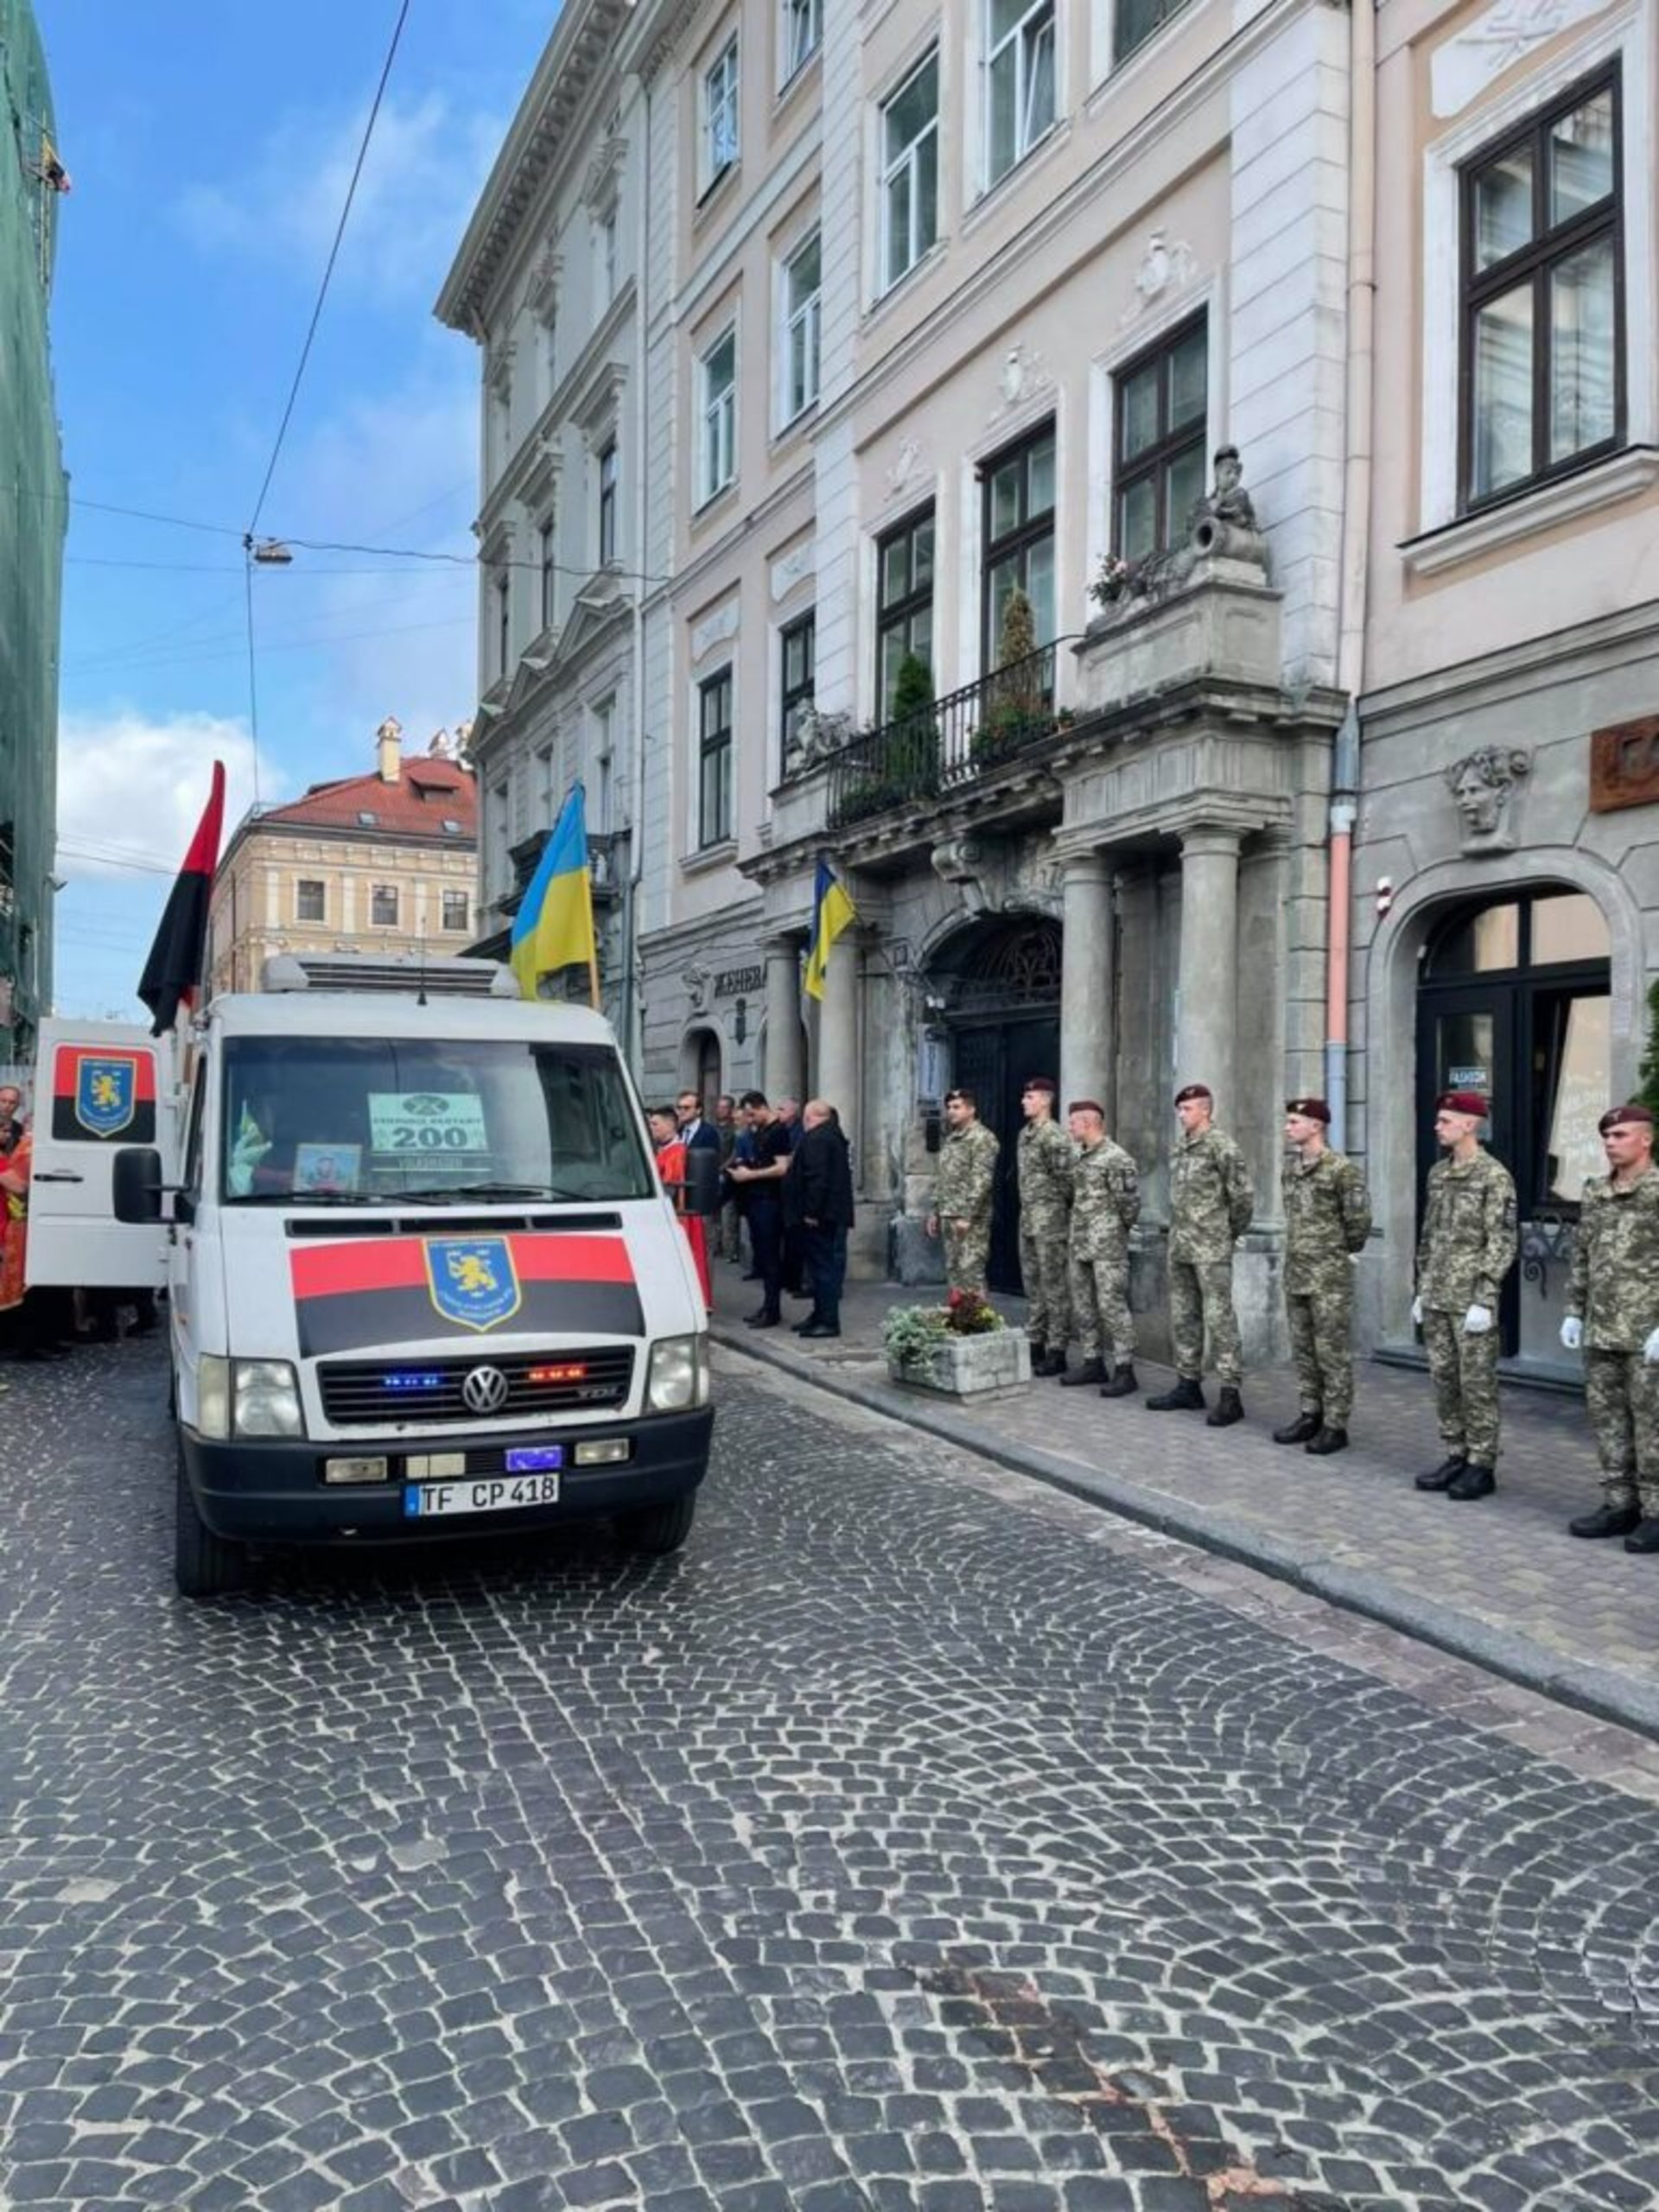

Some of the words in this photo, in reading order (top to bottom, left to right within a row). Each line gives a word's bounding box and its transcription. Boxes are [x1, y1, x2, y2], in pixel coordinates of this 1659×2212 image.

[392, 1127, 467, 1148] 200
[422, 1486, 454, 1511] TF
[472, 1483, 504, 1508] CP
[511, 1477, 555, 1503] 418
